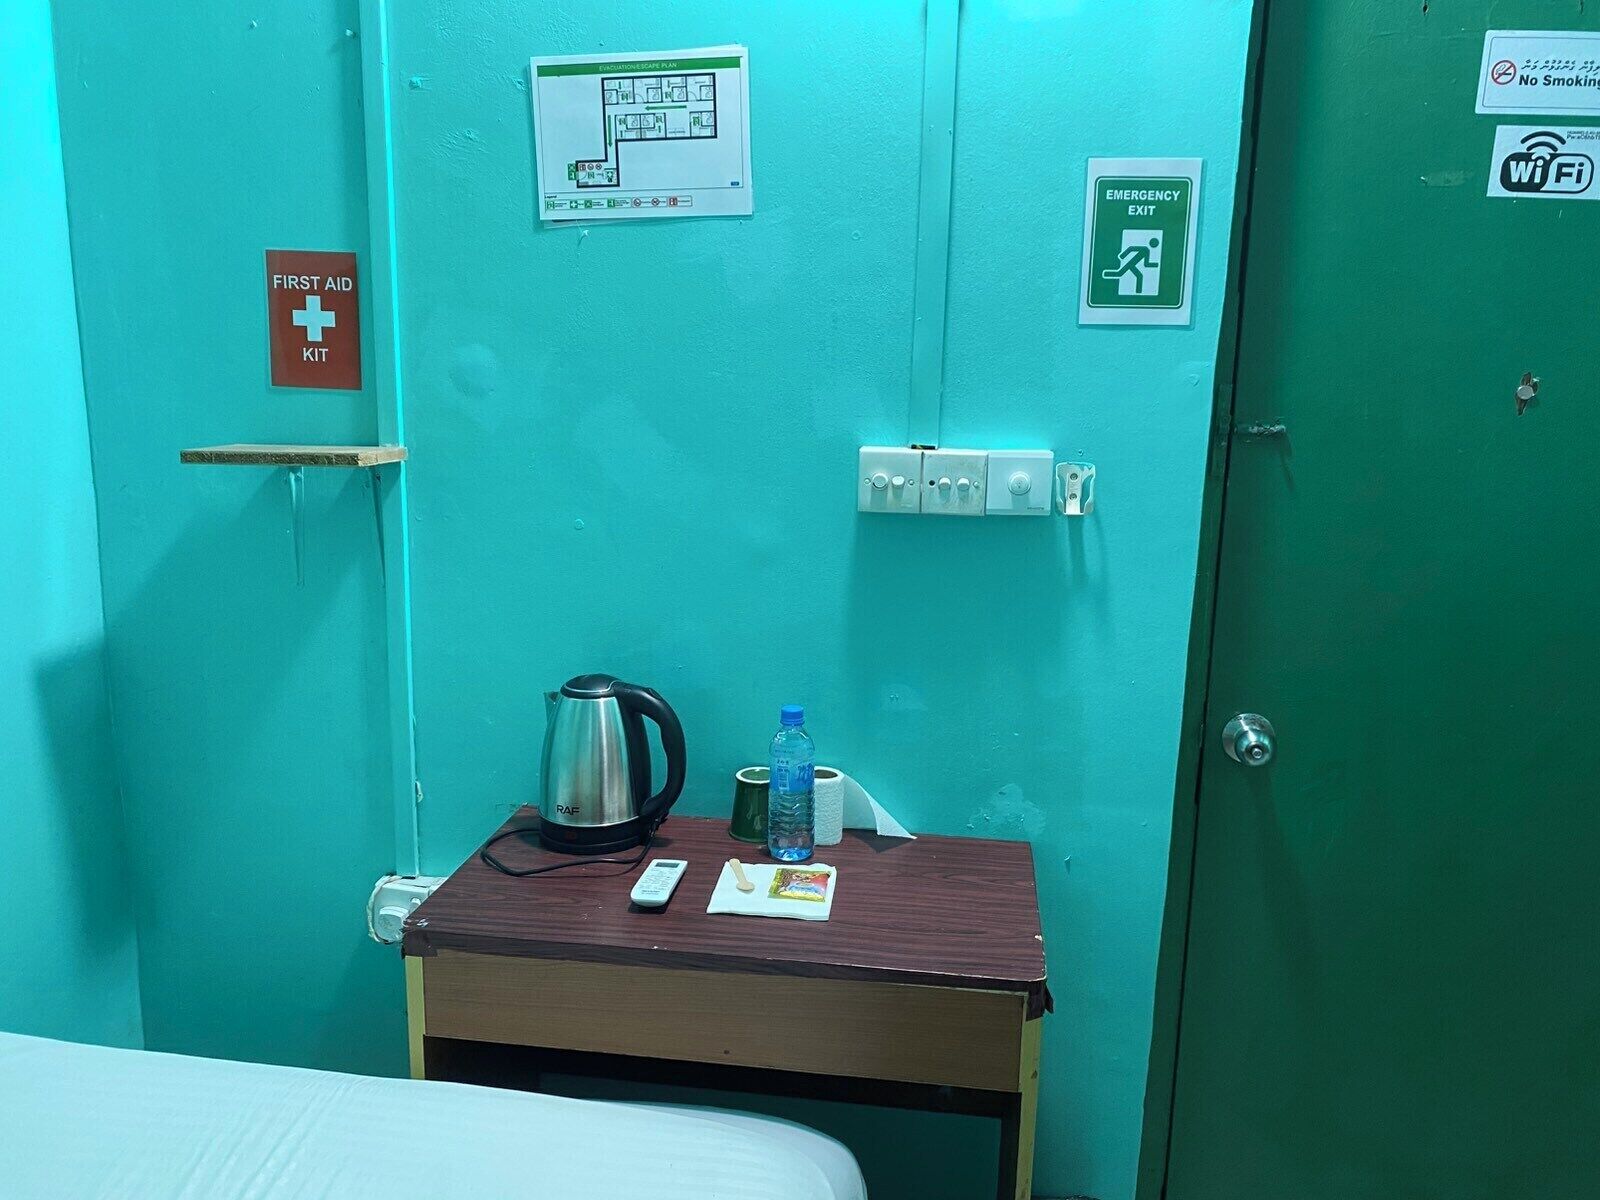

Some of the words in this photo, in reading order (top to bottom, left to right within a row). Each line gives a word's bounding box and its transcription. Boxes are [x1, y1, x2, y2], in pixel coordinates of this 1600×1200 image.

[599, 63, 660, 72] EVACUATION/ESCAPE
[1519, 75, 1538, 86] No
[1106, 189, 1180, 201] EMERGENCY
[1128, 205, 1156, 216] EXIT
[273, 274, 320, 290] FIRST
[325, 277, 352, 291] AID
[302, 347, 328, 362] KIT
[556, 804, 580, 815] RAF
